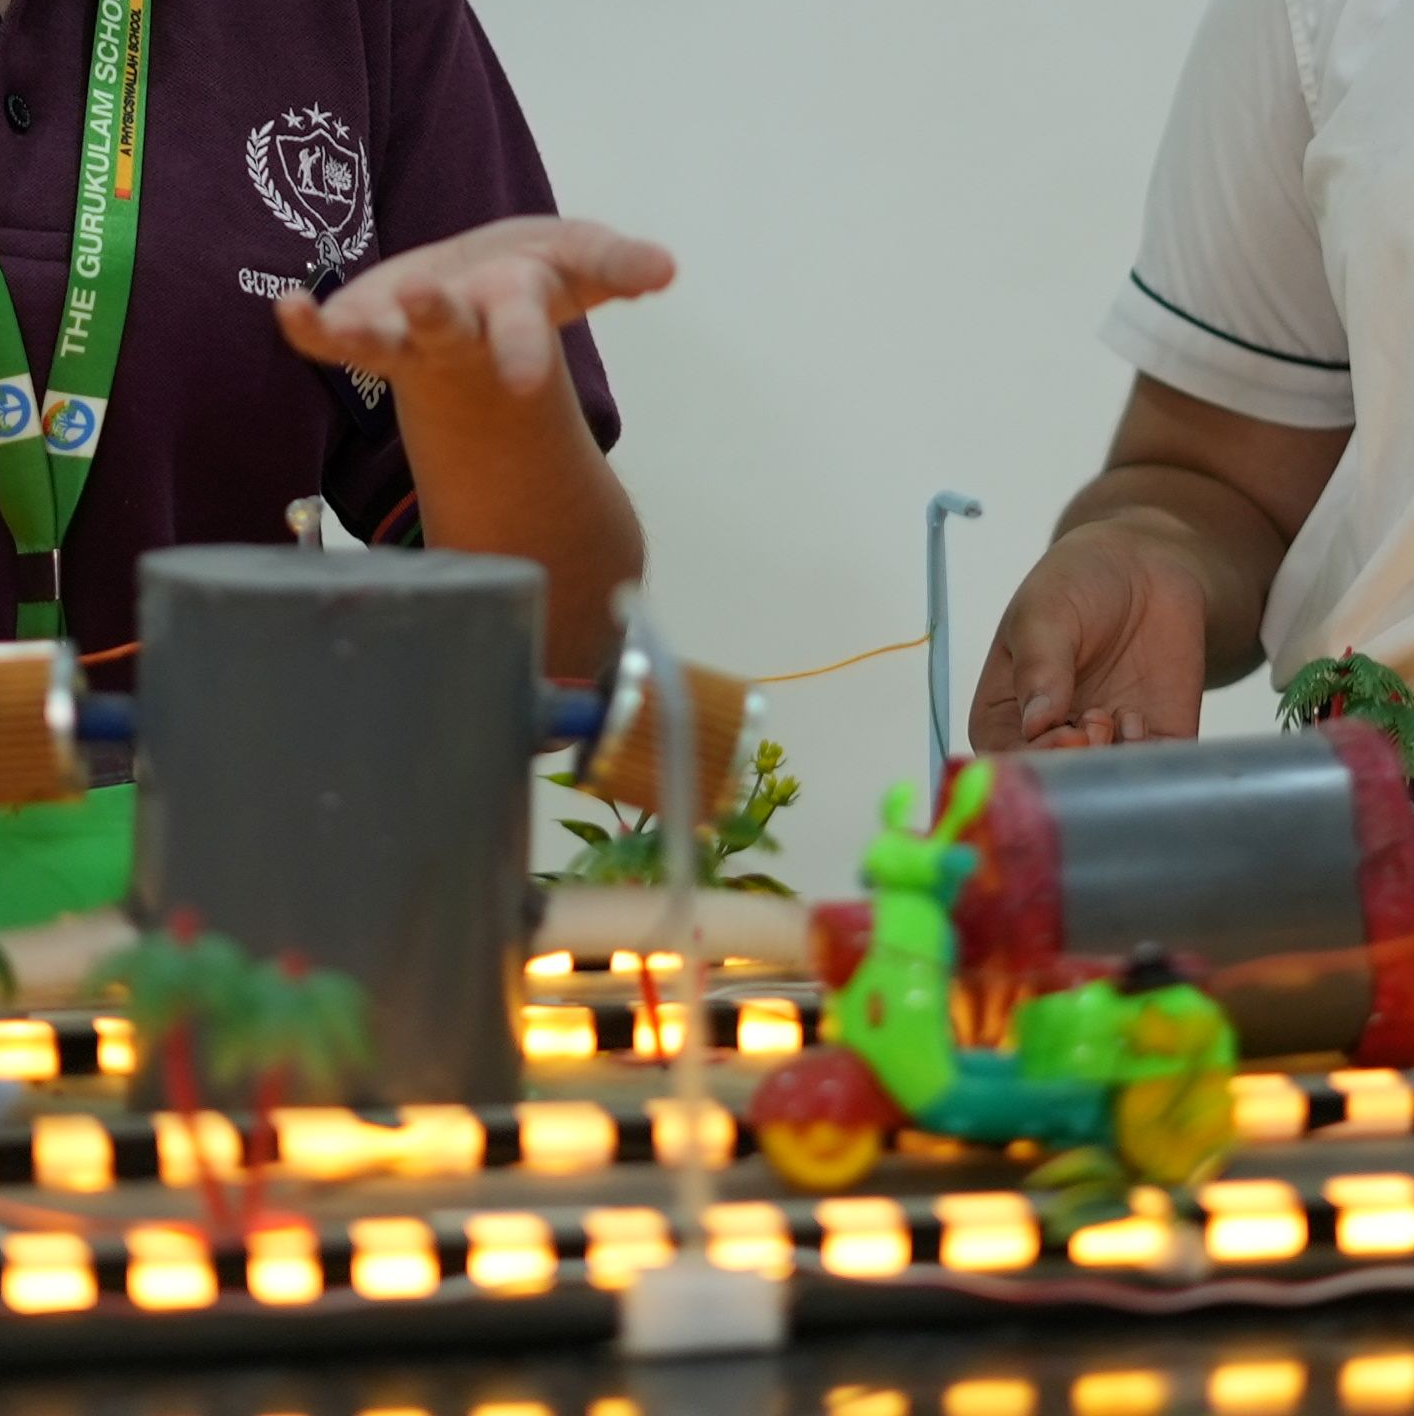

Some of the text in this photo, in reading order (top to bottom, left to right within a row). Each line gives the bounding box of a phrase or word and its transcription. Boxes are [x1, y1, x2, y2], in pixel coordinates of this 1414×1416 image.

[119, 8, 142, 158] A PHYSICSWALLAH SCHOOL
[75, 89, 115, 279] GURUKULAM
[60, 287, 97, 357] THE
